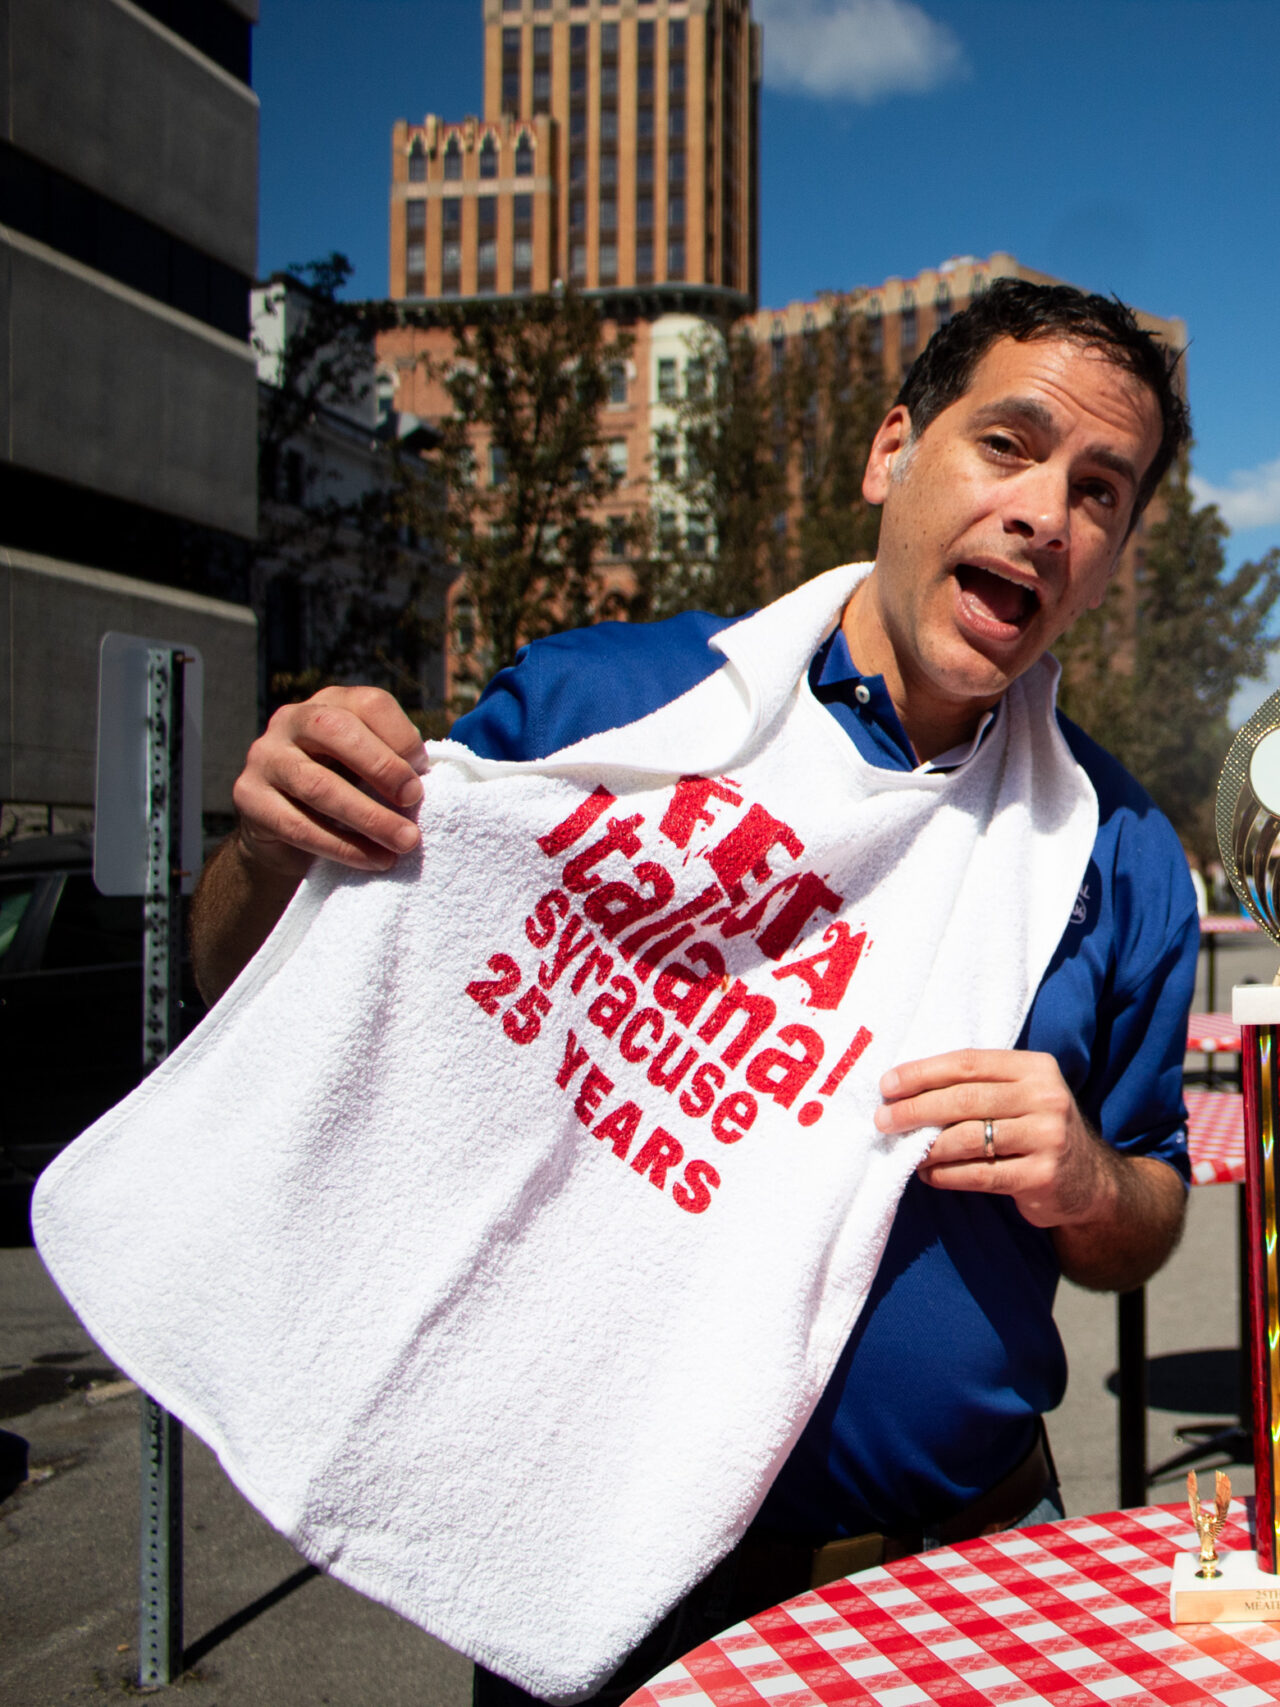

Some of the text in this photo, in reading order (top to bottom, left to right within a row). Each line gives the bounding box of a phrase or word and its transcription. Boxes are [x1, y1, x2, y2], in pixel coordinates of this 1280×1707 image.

[525, 888, 758, 1144] syracuse
[536, 784, 873, 1127] Italiana!
[658, 774, 875, 1010] FESTA
[464, 953, 721, 1214] 25 YEARS
